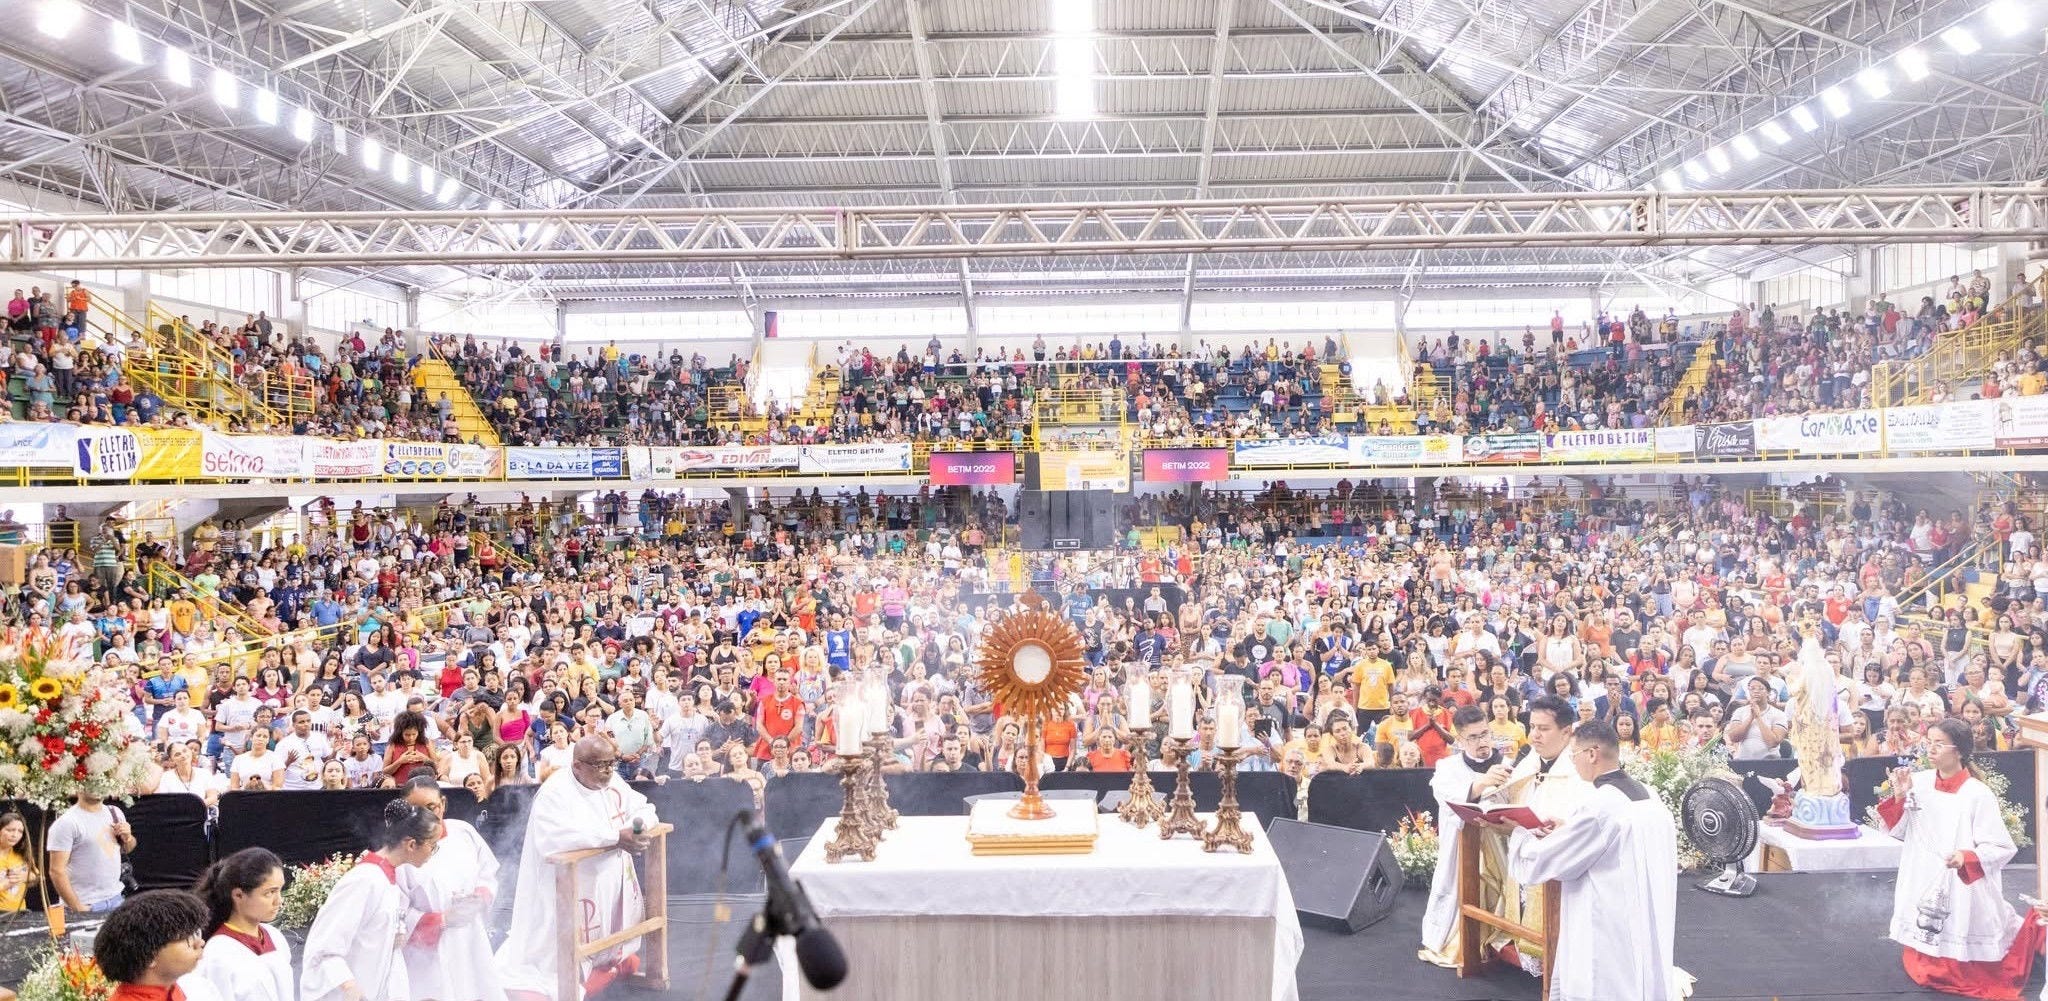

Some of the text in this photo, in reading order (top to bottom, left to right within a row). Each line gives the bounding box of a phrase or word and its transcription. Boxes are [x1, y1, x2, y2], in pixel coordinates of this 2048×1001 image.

[99, 434, 135, 454] ELETRO
[1562, 432, 1604, 446] ELETRO
[1607, 431, 1648, 445] BETIM
[101, 452, 137, 473] BETIM
[547, 461, 563, 469] DA
[567, 461, 589, 469] VEZ
[1162, 461, 1211, 470] BETIM 2022
[948, 465, 996, 474] BETIM 2022
